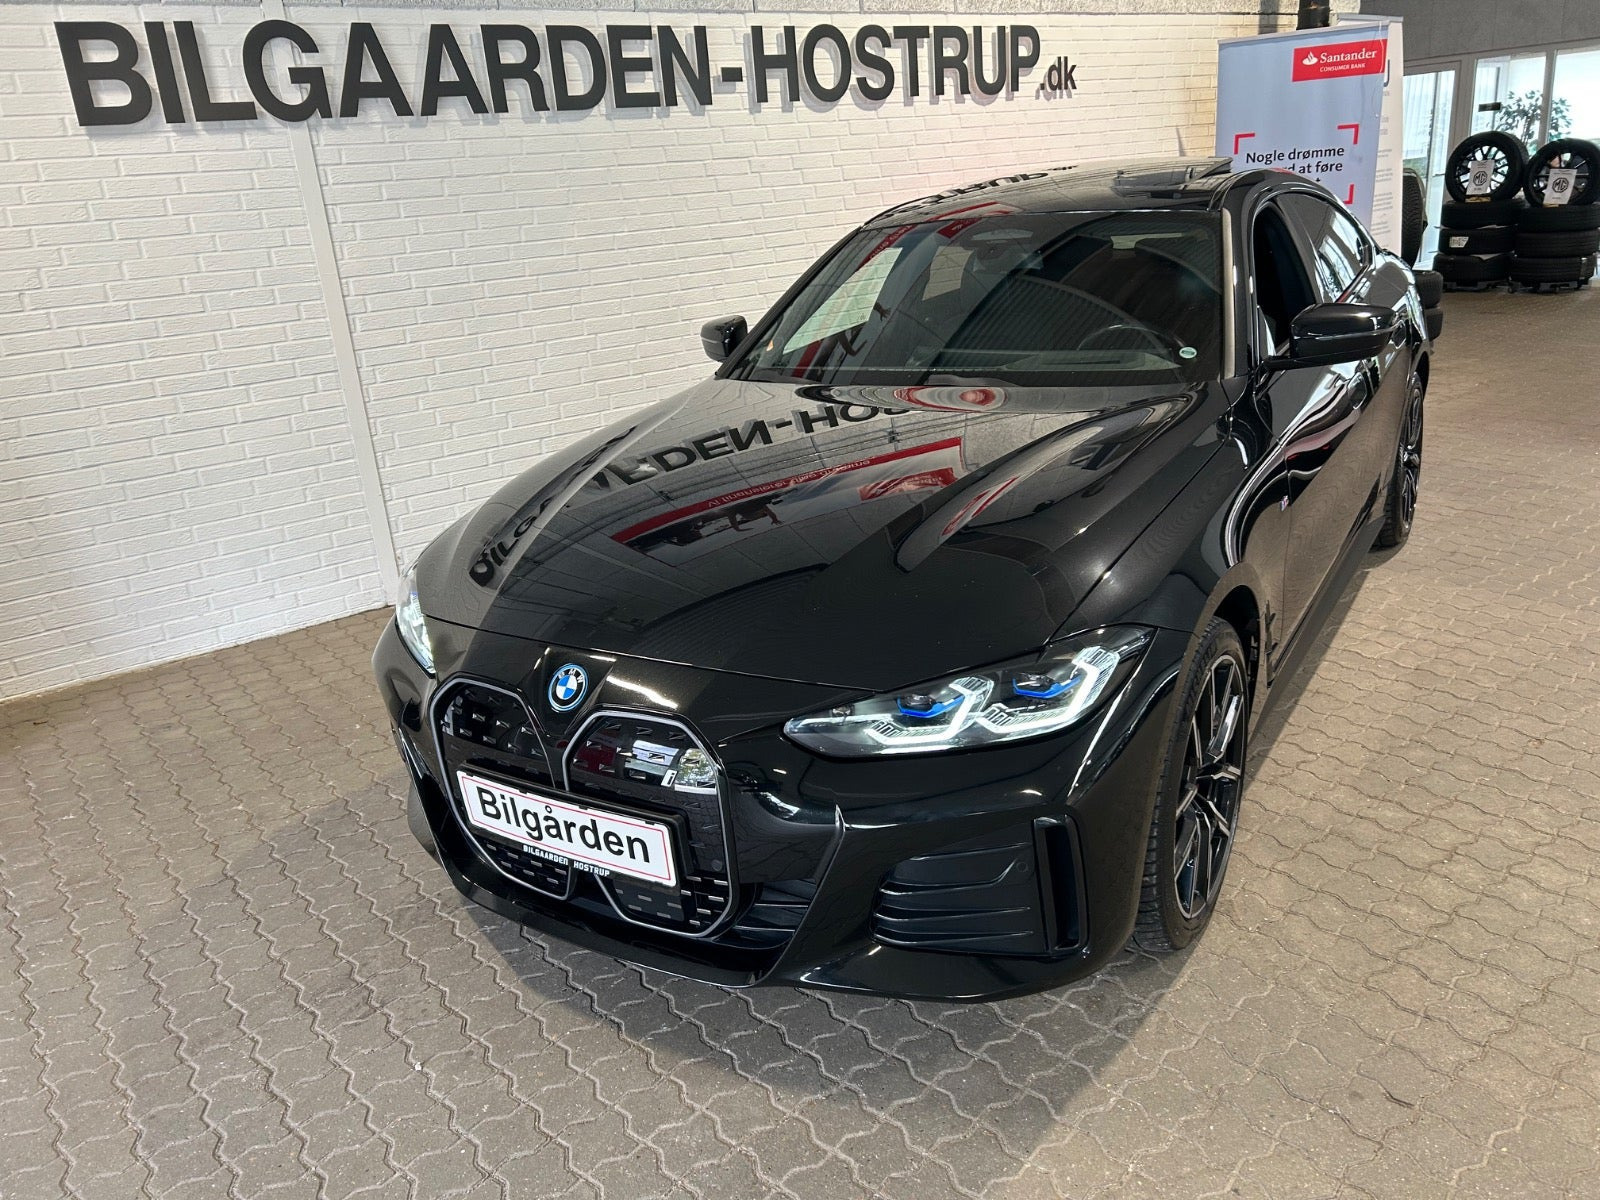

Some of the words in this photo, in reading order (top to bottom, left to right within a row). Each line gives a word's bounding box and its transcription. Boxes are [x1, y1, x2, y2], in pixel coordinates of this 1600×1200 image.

[1320, 48, 1377, 63] Santander
[1246, 149, 1285, 165] Nogle
[1288, 147, 1345, 160] drømme
[1298, 164, 1312, 174] at
[1316, 161, 1343, 173] føre
[1473, 171, 1487, 185] MG
[1552, 178, 1568, 192] MG
[476, 785, 651, 864] Bilgården
[522, 844, 569, 866] BILGAARDEN
[573, 860, 610, 877] HOSTRUP
